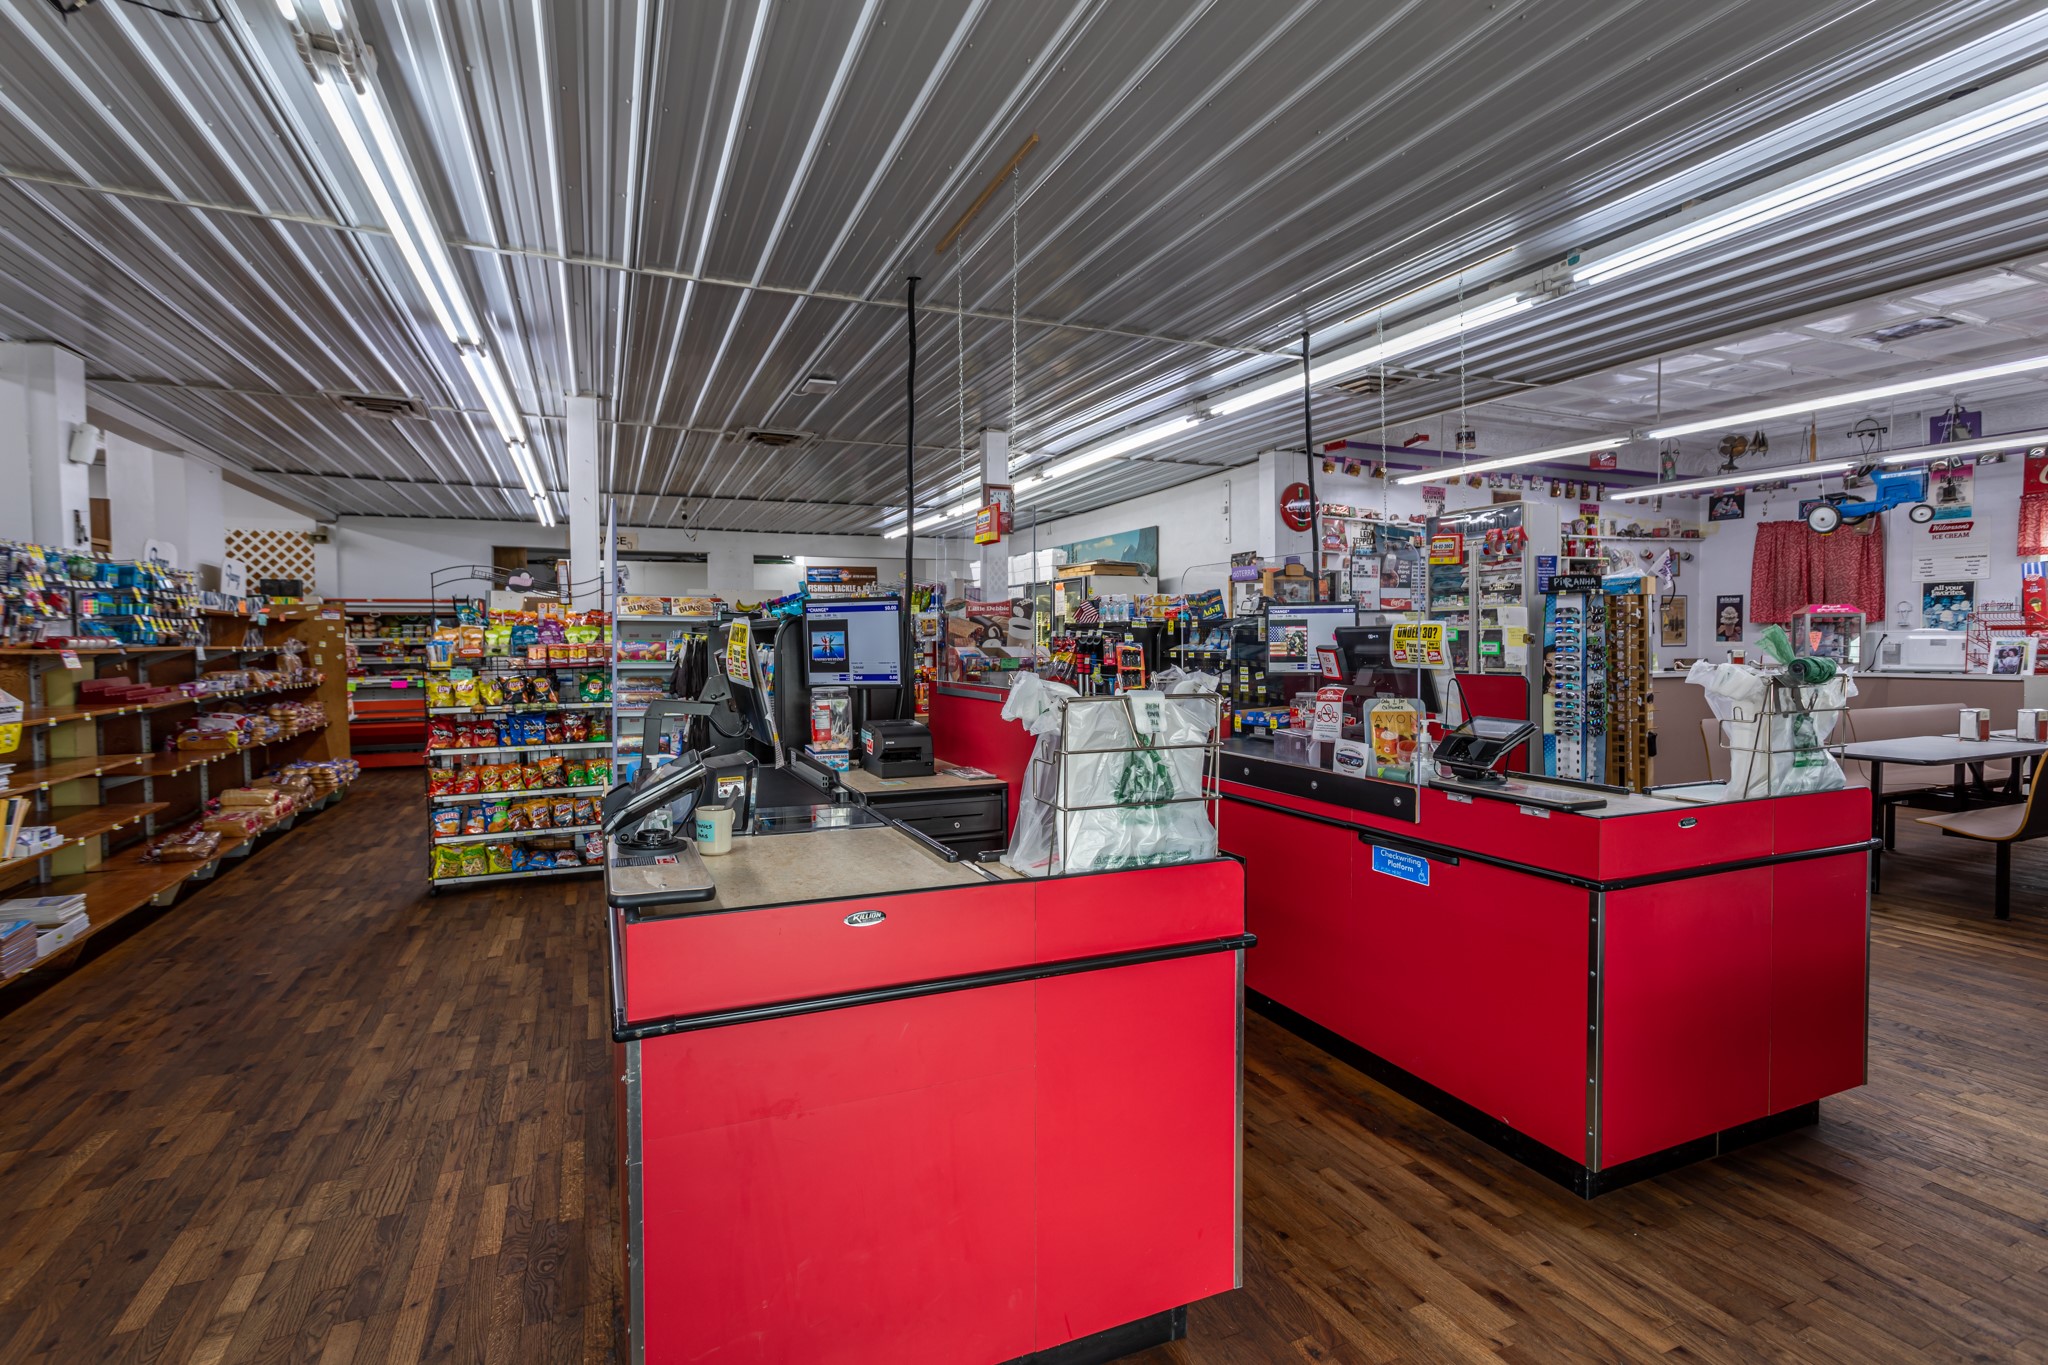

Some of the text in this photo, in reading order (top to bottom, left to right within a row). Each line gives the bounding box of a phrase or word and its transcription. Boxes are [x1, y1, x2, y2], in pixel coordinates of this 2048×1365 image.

[1360, 530, 1371, 538] LED
[808, 584, 832, 592] FISHING
[834, 584, 856, 592] TACKLE
[628, 604, 650, 612] BUNS
[678, 604, 701, 612] BUNS
[1202, 604, 1221, 617] Advil
[1398, 626, 1438, 638] UNDE 30?
[1374, 714, 1418, 724] AVON
[1380, 850, 1422, 868] Checkwriting
[1388, 860, 1414, 872] Platform
[852, 912, 882, 922] KILLION
